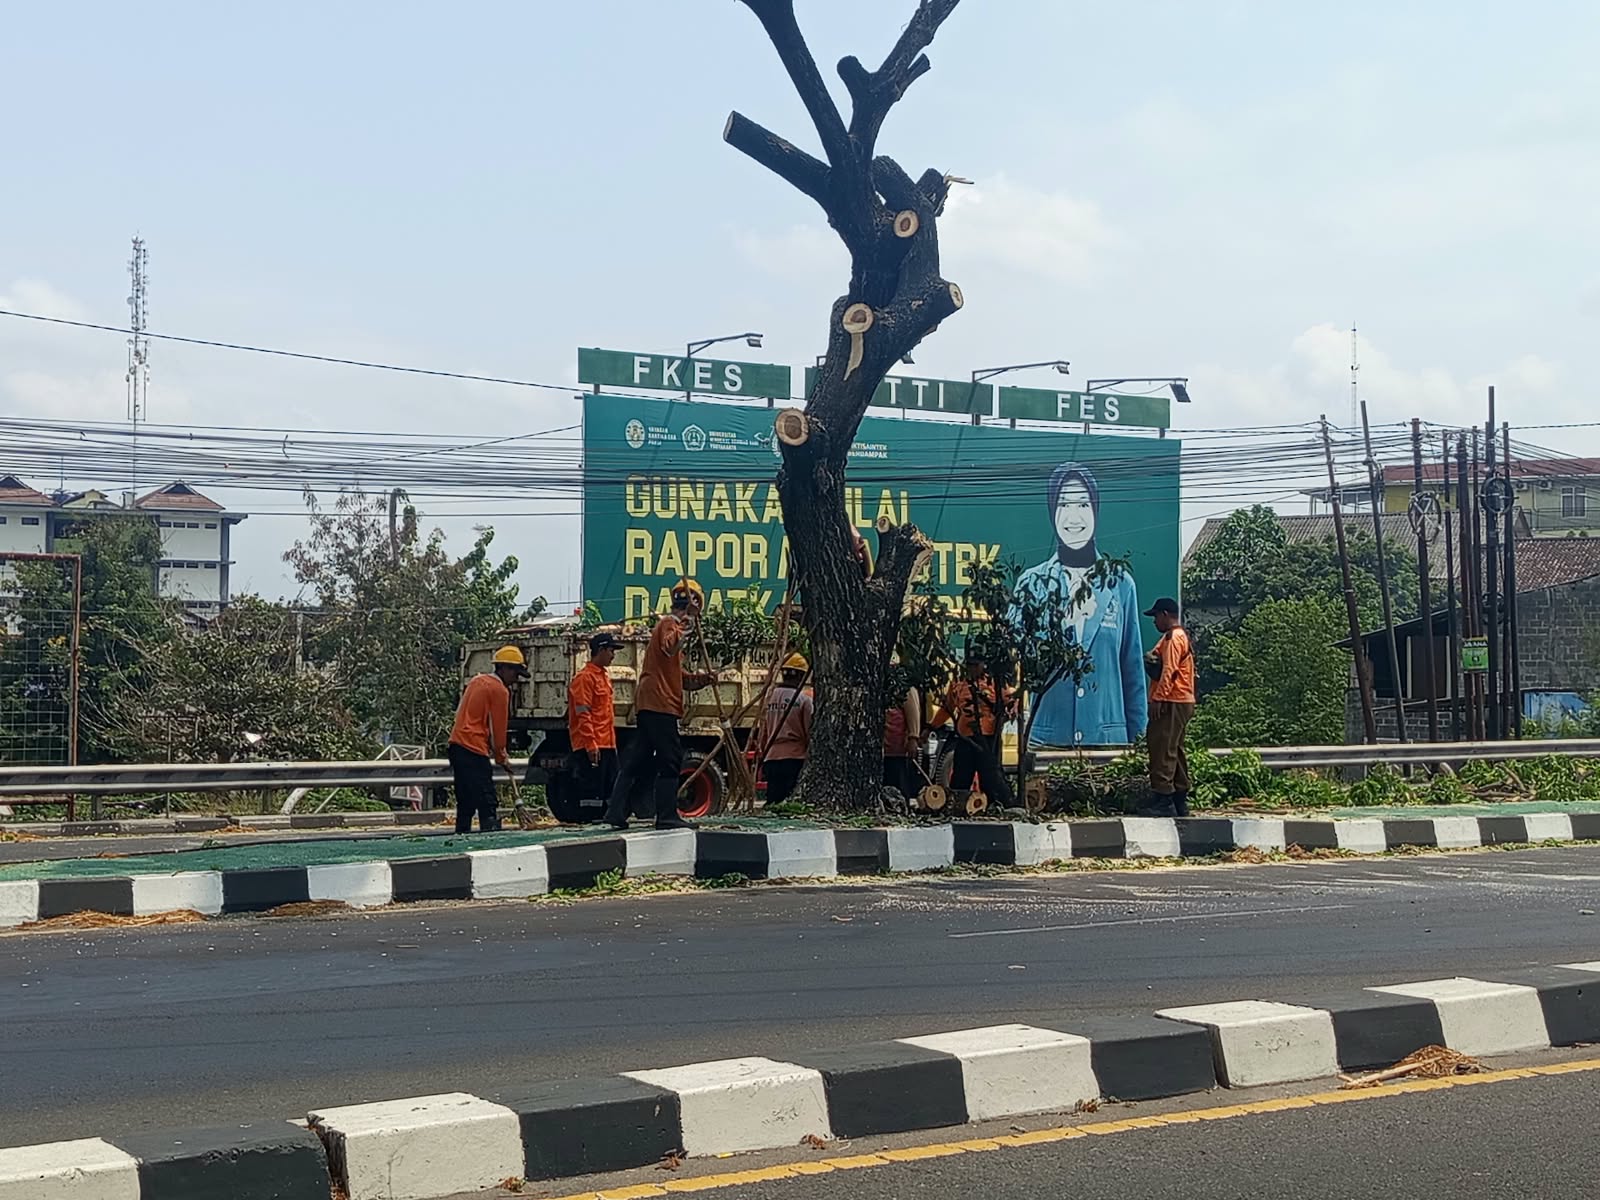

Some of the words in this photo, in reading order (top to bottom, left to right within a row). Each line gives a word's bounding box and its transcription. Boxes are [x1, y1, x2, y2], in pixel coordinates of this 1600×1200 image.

[633, 356, 742, 392] FKES
[884, 376, 944, 409] TTI
[1057, 393, 1120, 422] FES
[625, 474, 785, 525] GUNAKA
[845, 487, 908, 528] ILAI
[625, 528, 769, 580] RAPOR
[918, 541, 1001, 586] TBK
